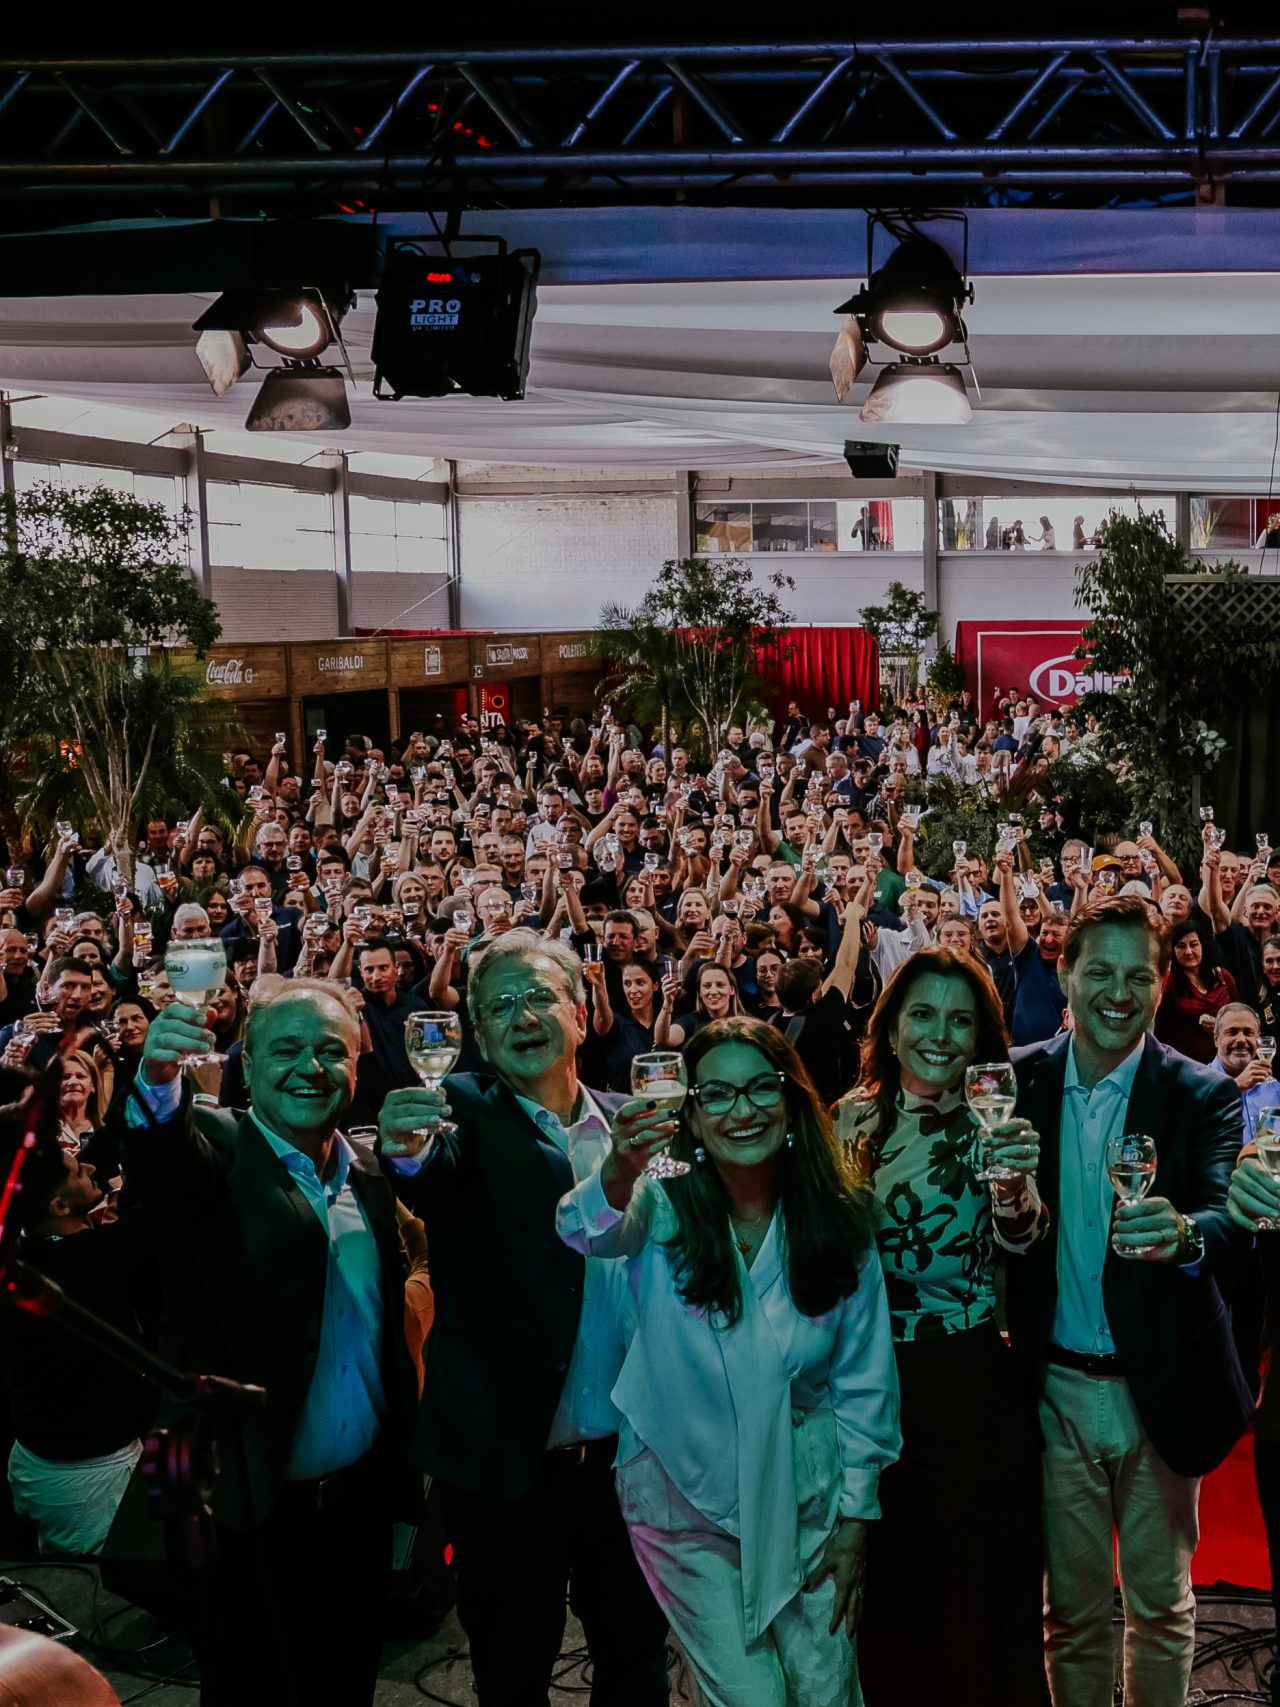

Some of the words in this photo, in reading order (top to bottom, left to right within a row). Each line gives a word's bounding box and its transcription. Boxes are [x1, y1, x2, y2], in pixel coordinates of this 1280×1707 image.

[409, 299, 461, 314] PRO
[414, 315, 458, 324] LIGHT
[560, 644, 587, 659] POLENTA
[318, 655, 363, 672] GARIBALDI
